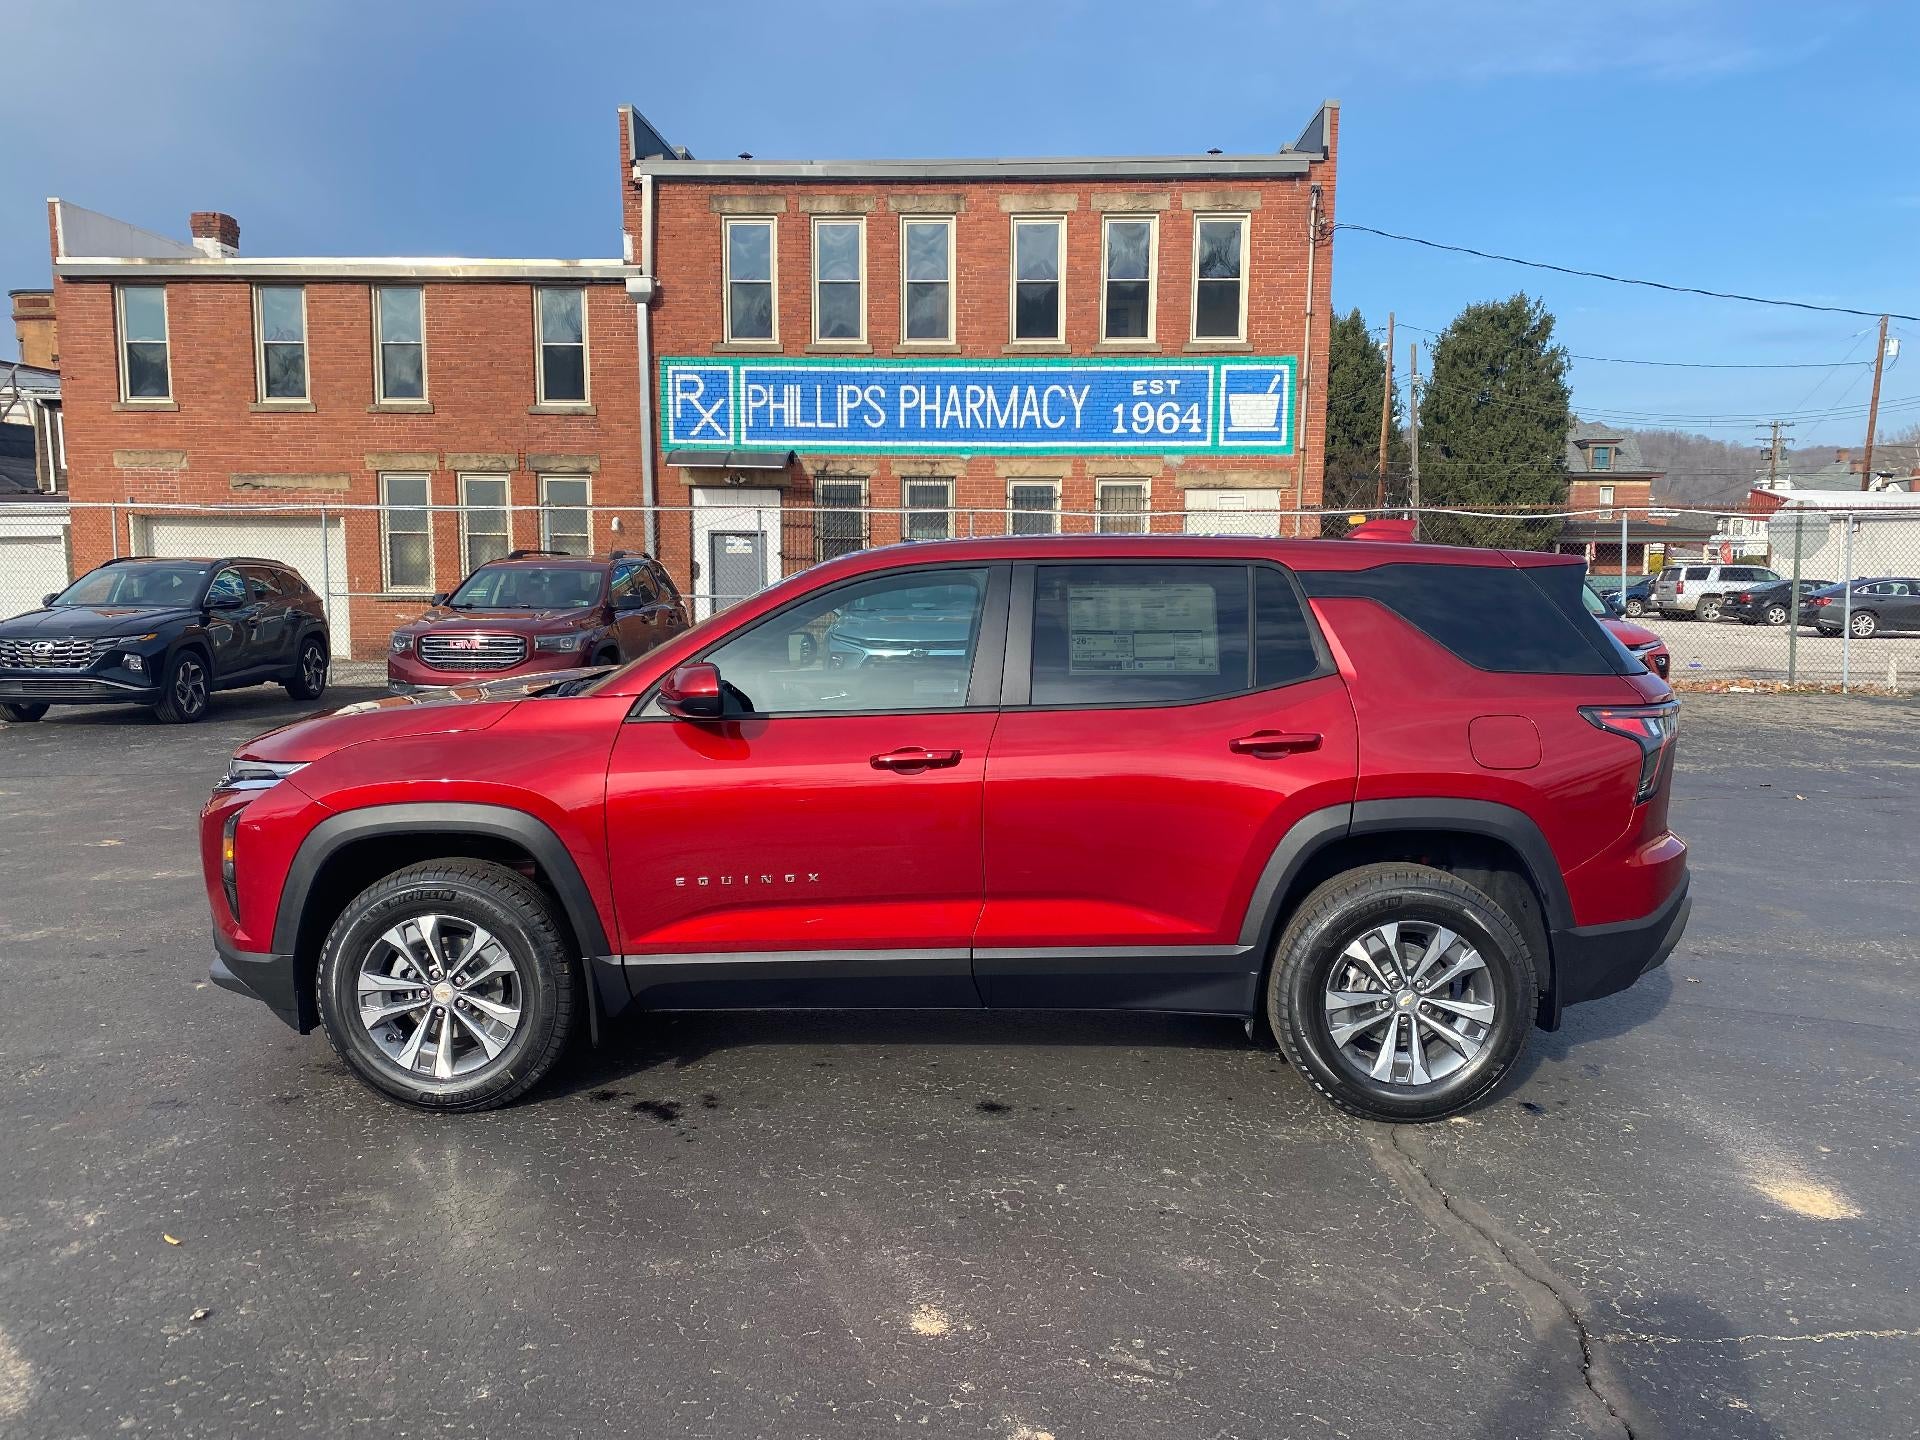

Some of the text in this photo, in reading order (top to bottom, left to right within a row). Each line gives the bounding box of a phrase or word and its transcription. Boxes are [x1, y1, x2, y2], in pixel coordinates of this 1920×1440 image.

[1132, 380, 1181, 396] EST
[748, 384, 1090, 429] PHILLIPS PHARMACY
[1112, 402, 1202, 434] 1964
[449, 639, 489, 650] GMC
[675, 872, 820, 887] EQUINOX
[389, 890, 455, 906] MICHELIN
